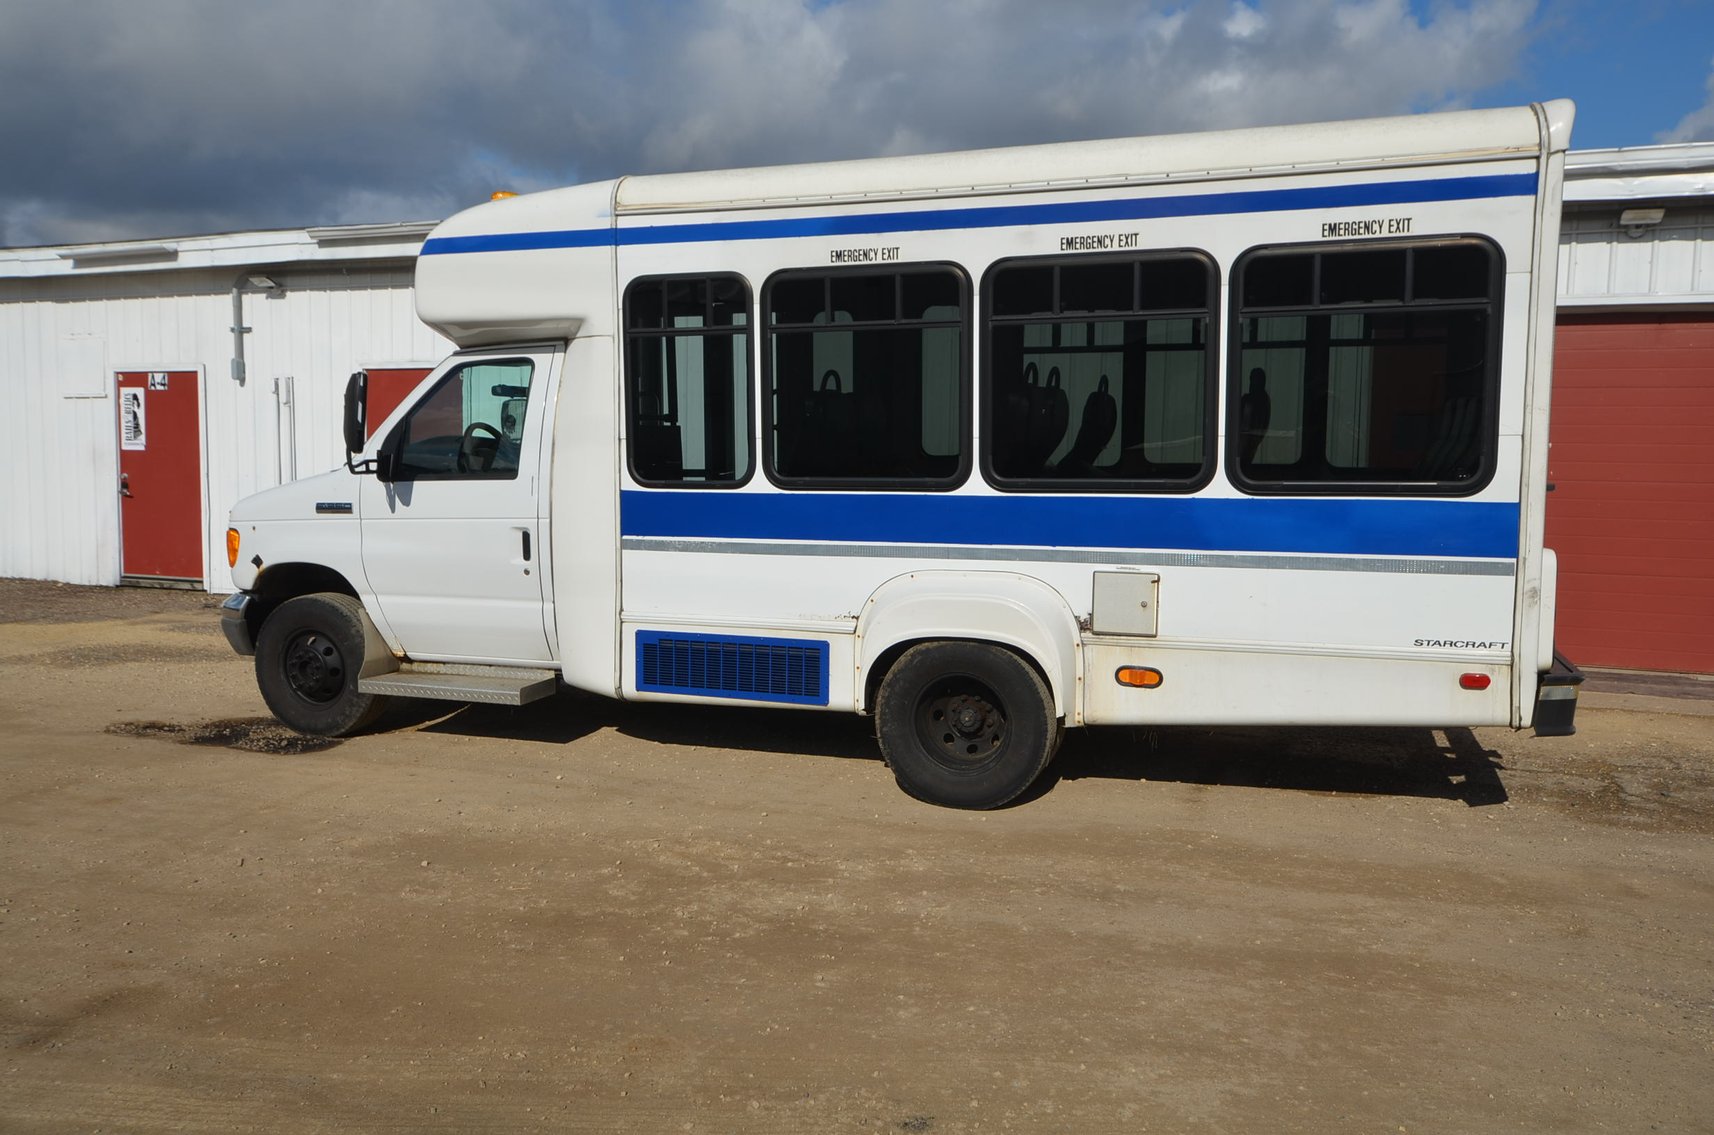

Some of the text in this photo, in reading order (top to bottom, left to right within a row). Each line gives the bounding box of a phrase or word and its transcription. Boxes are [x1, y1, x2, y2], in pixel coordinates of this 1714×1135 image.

[1321, 217, 1412, 238] EMERGENCY EXIT
[1060, 232, 1139, 251] EMERGENCY EXIT
[830, 246, 900, 263] EMERGENCY EXIT
[149, 373, 167, 390] A-4
[1413, 639, 1509, 649] STARCRAFT
